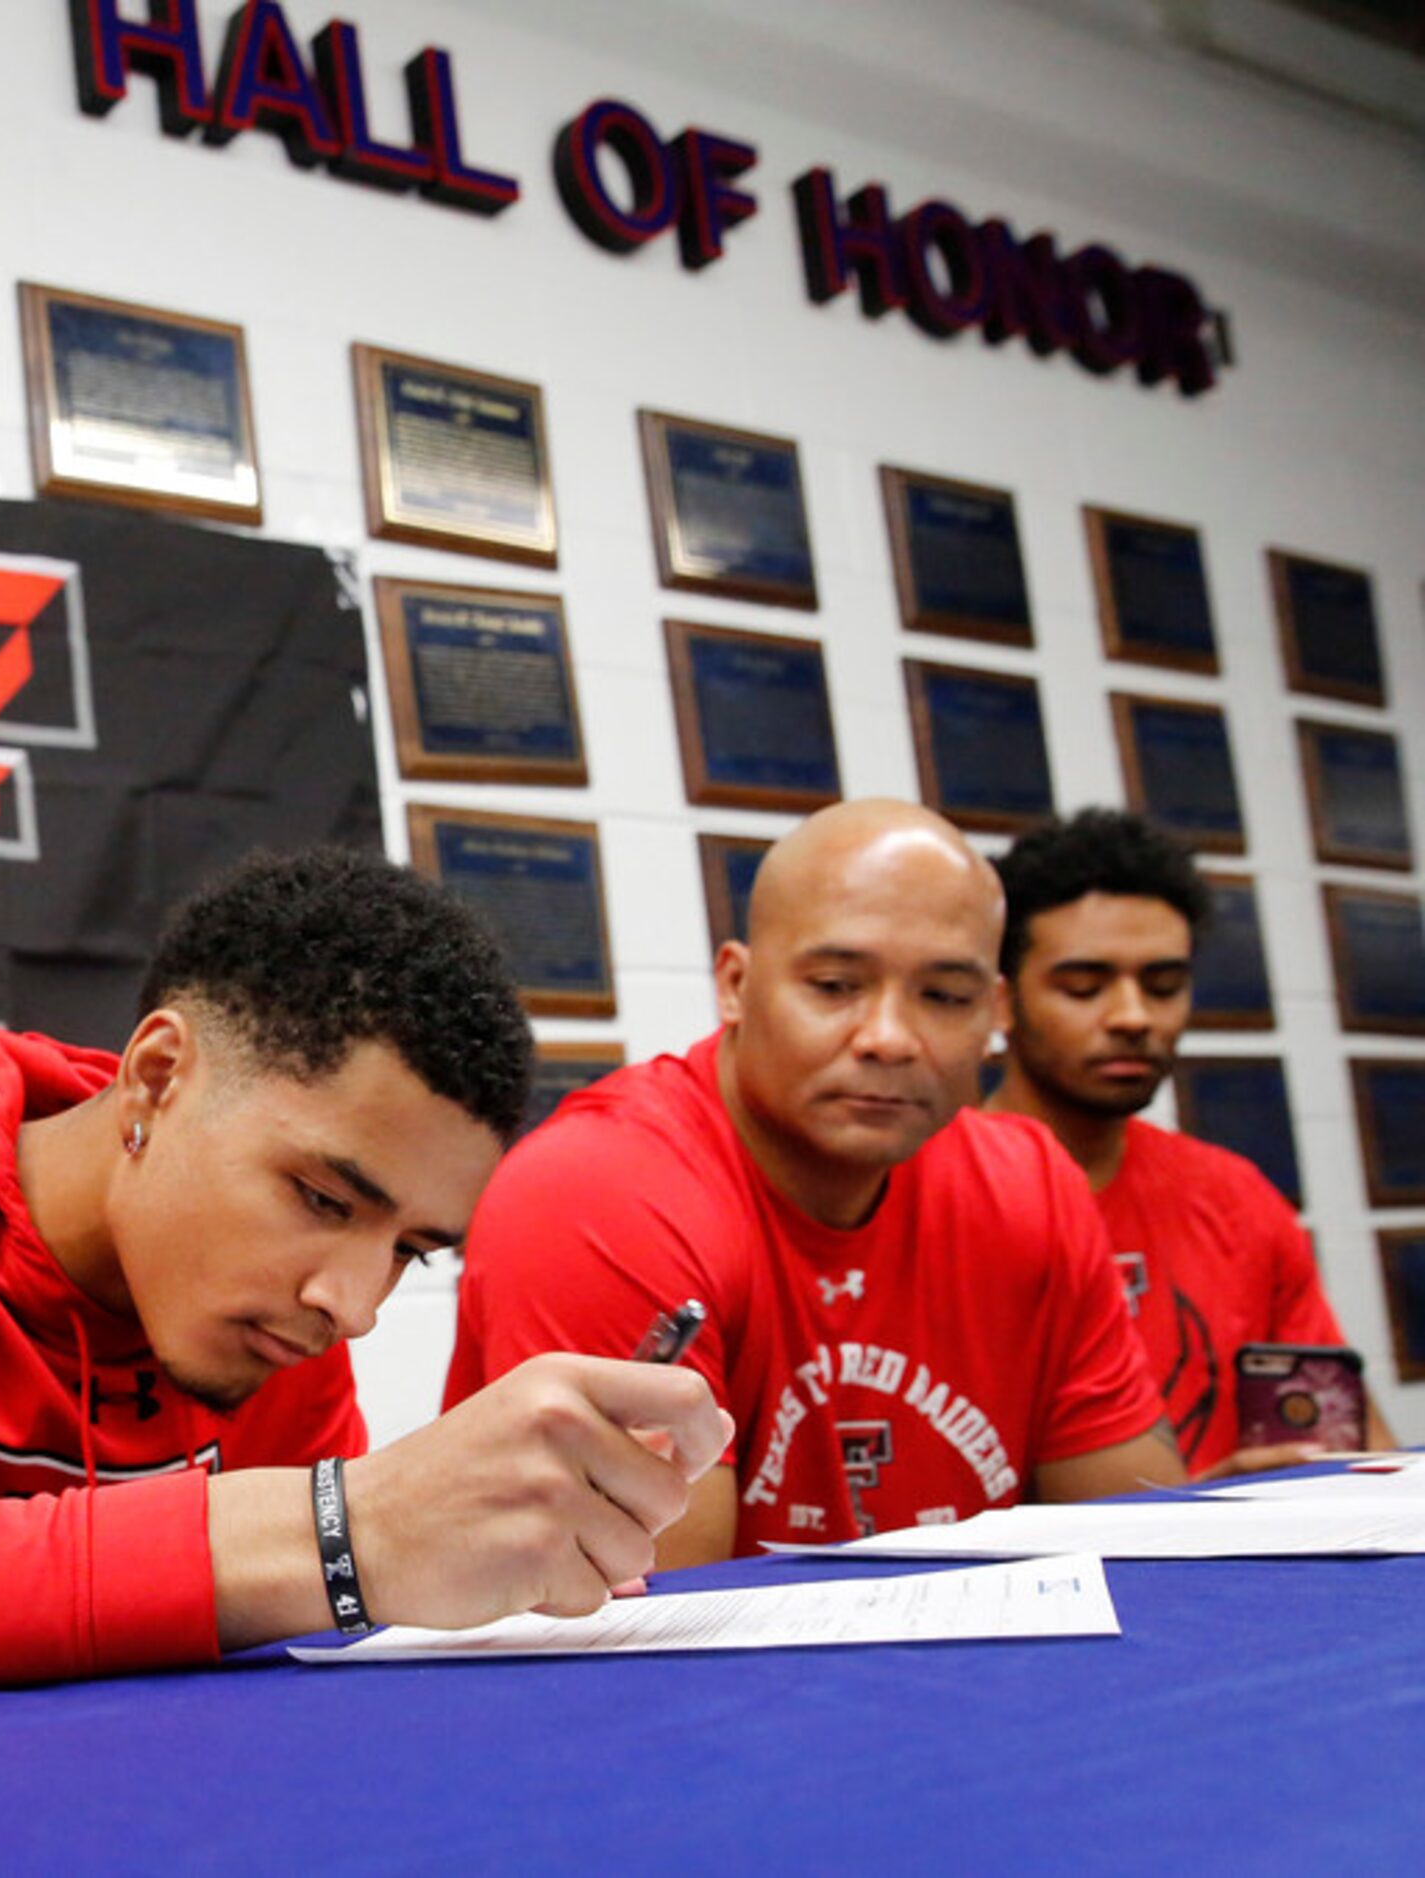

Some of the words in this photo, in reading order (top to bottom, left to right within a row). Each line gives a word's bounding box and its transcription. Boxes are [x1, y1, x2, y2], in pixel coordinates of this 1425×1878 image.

[73, 0, 521, 217] HALL
[552, 98, 760, 272] OF
[791, 167, 1216, 397] HONOR
[838, 1342, 908, 1395] RED
